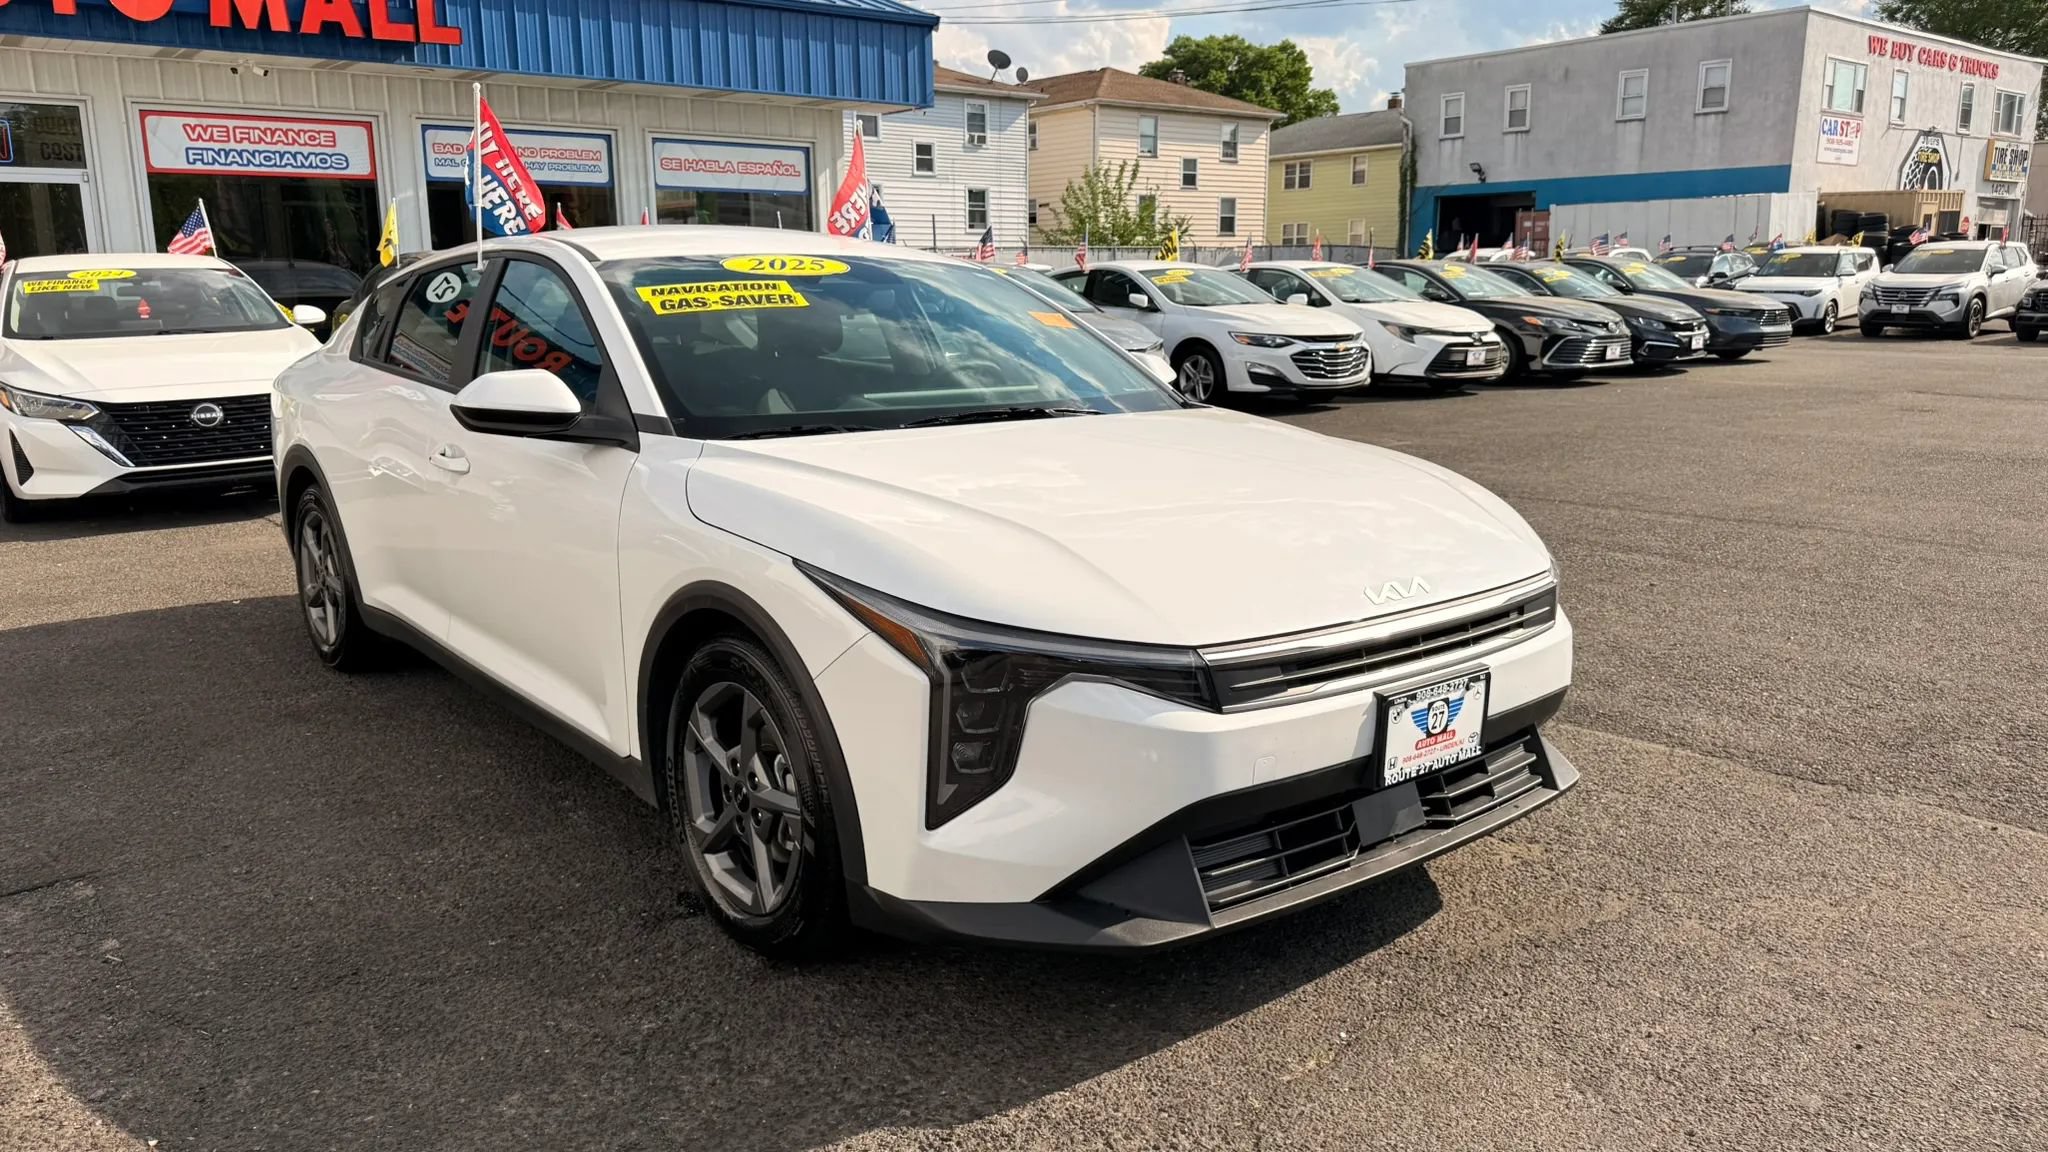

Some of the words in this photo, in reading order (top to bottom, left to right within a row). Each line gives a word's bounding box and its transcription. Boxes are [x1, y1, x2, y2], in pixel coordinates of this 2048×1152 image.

[1868, 35, 1888, 56] WE
[1890, 41, 1916, 62] BUY
[1918, 47, 1948, 69] CARS
[1959, 55, 2000, 80] TRUCKS
[183, 124, 230, 142] WE
[234, 126, 336, 148] FINANCE
[1821, 118, 1839, 137] CAR
[185, 147, 349, 171] FINANCIAMOS
[433, 143, 463, 154] BAD
[518, 148, 538, 158] NO
[540, 149, 602, 161] PROBLEM
[1993, 146, 2008, 164] TIRE
[2008, 148, 2029, 167] SHOP
[434, 157, 460, 167] MAL
[524, 161, 547, 170] HAY
[547, 162, 602, 173] PROBLEMA
[660, 157, 682, 171] SE
[684, 158, 735, 174] HABLA
[737, 160, 801, 177] ESPAÑOL
[79, 270, 125, 278] 2024
[748, 258, 825, 271] 2025
[651, 283, 777, 297] NAVIGATION
[660, 293, 795, 312] GAS-SAVER
[1431, 704, 1446, 713] ROUTE
[1431, 710, 1445, 731] 27
[1417, 736, 1435, 749] AUTO
[1436, 731, 1455, 744] MALL
[1385, 765, 1418, 787] ROUTE
[1418, 761, 1433, 776] 27
[1432, 753, 1457, 771] AUTO
[1458, 745, 1482, 764] MALL
